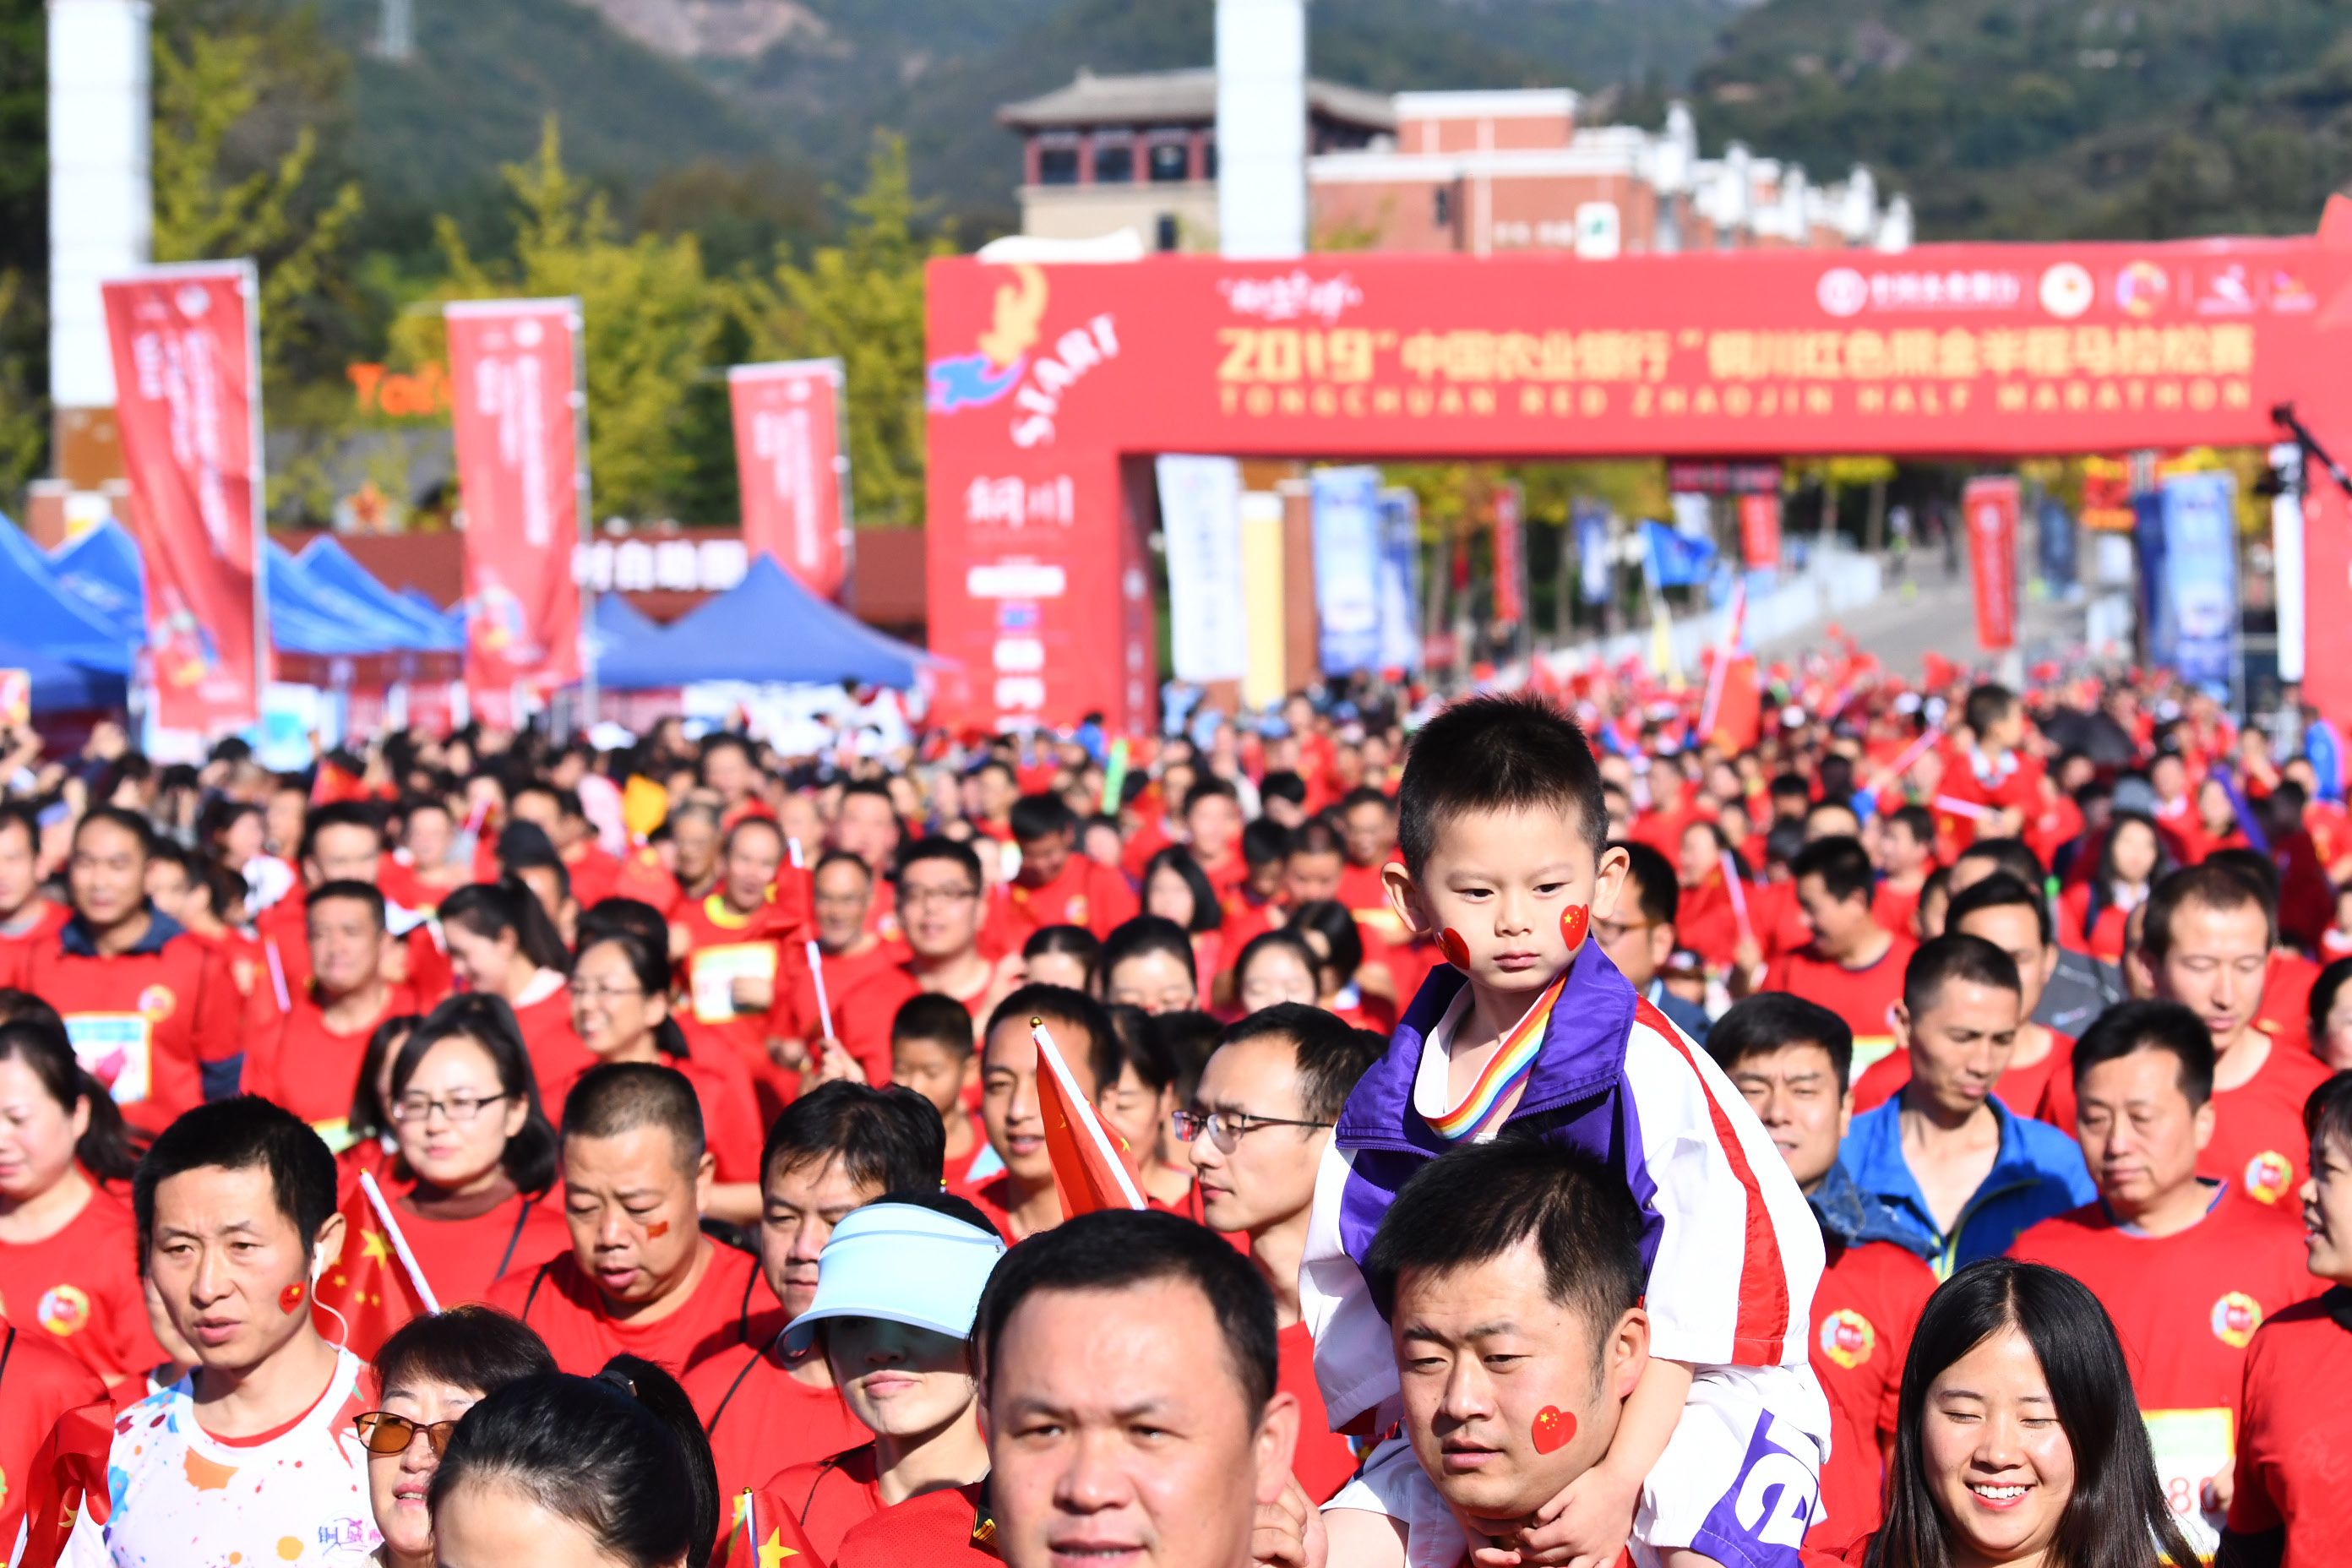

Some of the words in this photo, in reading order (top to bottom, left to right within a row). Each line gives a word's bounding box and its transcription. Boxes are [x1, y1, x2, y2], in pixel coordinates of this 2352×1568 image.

[1011, 310, 1120, 448] START
[1221, 388, 1494, 416] TONGCHUAN
[1519, 386, 1607, 417] RED
[1631, 384, 1832, 417] ZHAOJIN
[1856, 383, 1970, 414] HALF
[1995, 379, 2251, 413] MARATHON
